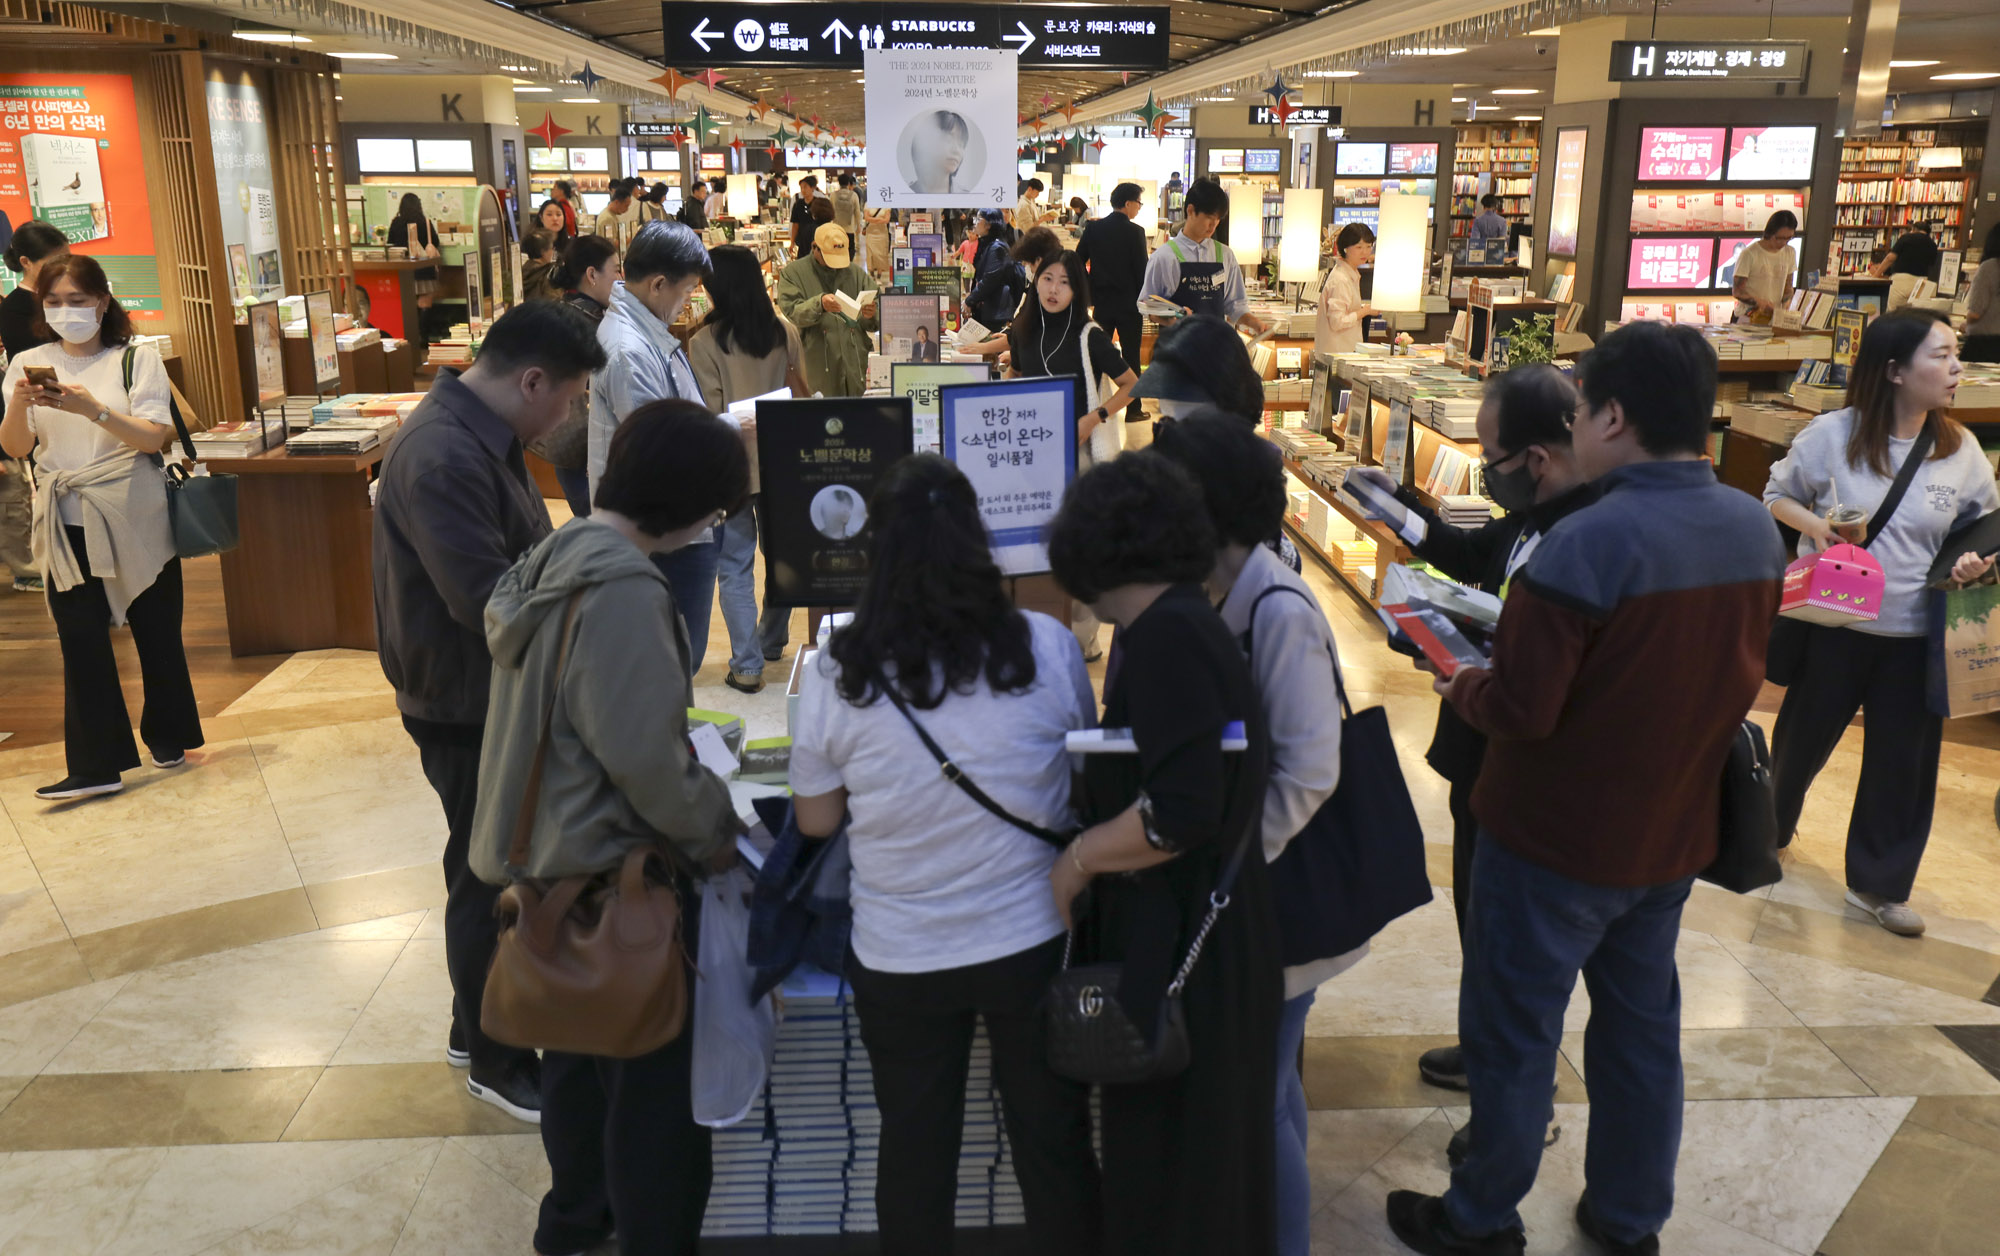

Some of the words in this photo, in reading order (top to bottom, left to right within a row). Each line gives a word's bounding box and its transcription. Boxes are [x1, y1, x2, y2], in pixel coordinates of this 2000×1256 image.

[769, 22, 790, 36] 셀프
[891, 20, 976, 32] STARBUCKS
[1044, 19, 1081, 33] 문보장
[1146, 21, 1156, 34] 숲
[769, 37, 809, 51] 바로결제
[1044, 44, 1101, 57] 서비스데스크
[889, 61, 909, 71] THE
[910, 61, 931, 71] 2024
[933, 61, 964, 71] NOBEL
[966, 61, 993, 71] PRIZE
[1631, 46, 1655, 76] H
[1725, 50, 1752, 67] 경제
[1759, 50, 1786, 67] 경영
[907, 75, 917, 84] IN
[919, 75, 976, 84] LITERATURE
[904, 88, 933, 98] 2024년
[935, 88, 977, 98] 노벨문학상
[225, 97, 263, 125] SENSE
[441, 93, 465, 121] K
[1257, 107, 1269, 123] H
[1414, 99, 1435, 125] H
[4, 114, 30, 130] 6년
[34, 115, 66, 131] 만의
[70, 115, 106, 131] 신작!
[586, 115, 602, 135] K
[627, 124, 637, 135] K
[1650, 142, 1713, 161] 수석합격
[879, 186, 894, 203] 한
[991, 186, 1006, 203] 강
[1679, 243, 1700, 260] 1위
[1850, 240, 1857, 249] H
[1861, 240, 1868, 249] 7
[1640, 261, 1700, 283] 박문각
[982, 406, 1011, 427] 한강
[1016, 408, 1037, 421] 저자
[961, 429, 1012, 449] <소년이
[1016, 426, 1054, 447] 온다>
[800, 448, 872, 463] 노벨문학상
[987, 449, 1034, 468] 일시품절
[1013, 492, 1027, 503] 주문
[1029, 489, 1053, 501] 예약은
[1016, 502, 1052, 515] 문의주세요
